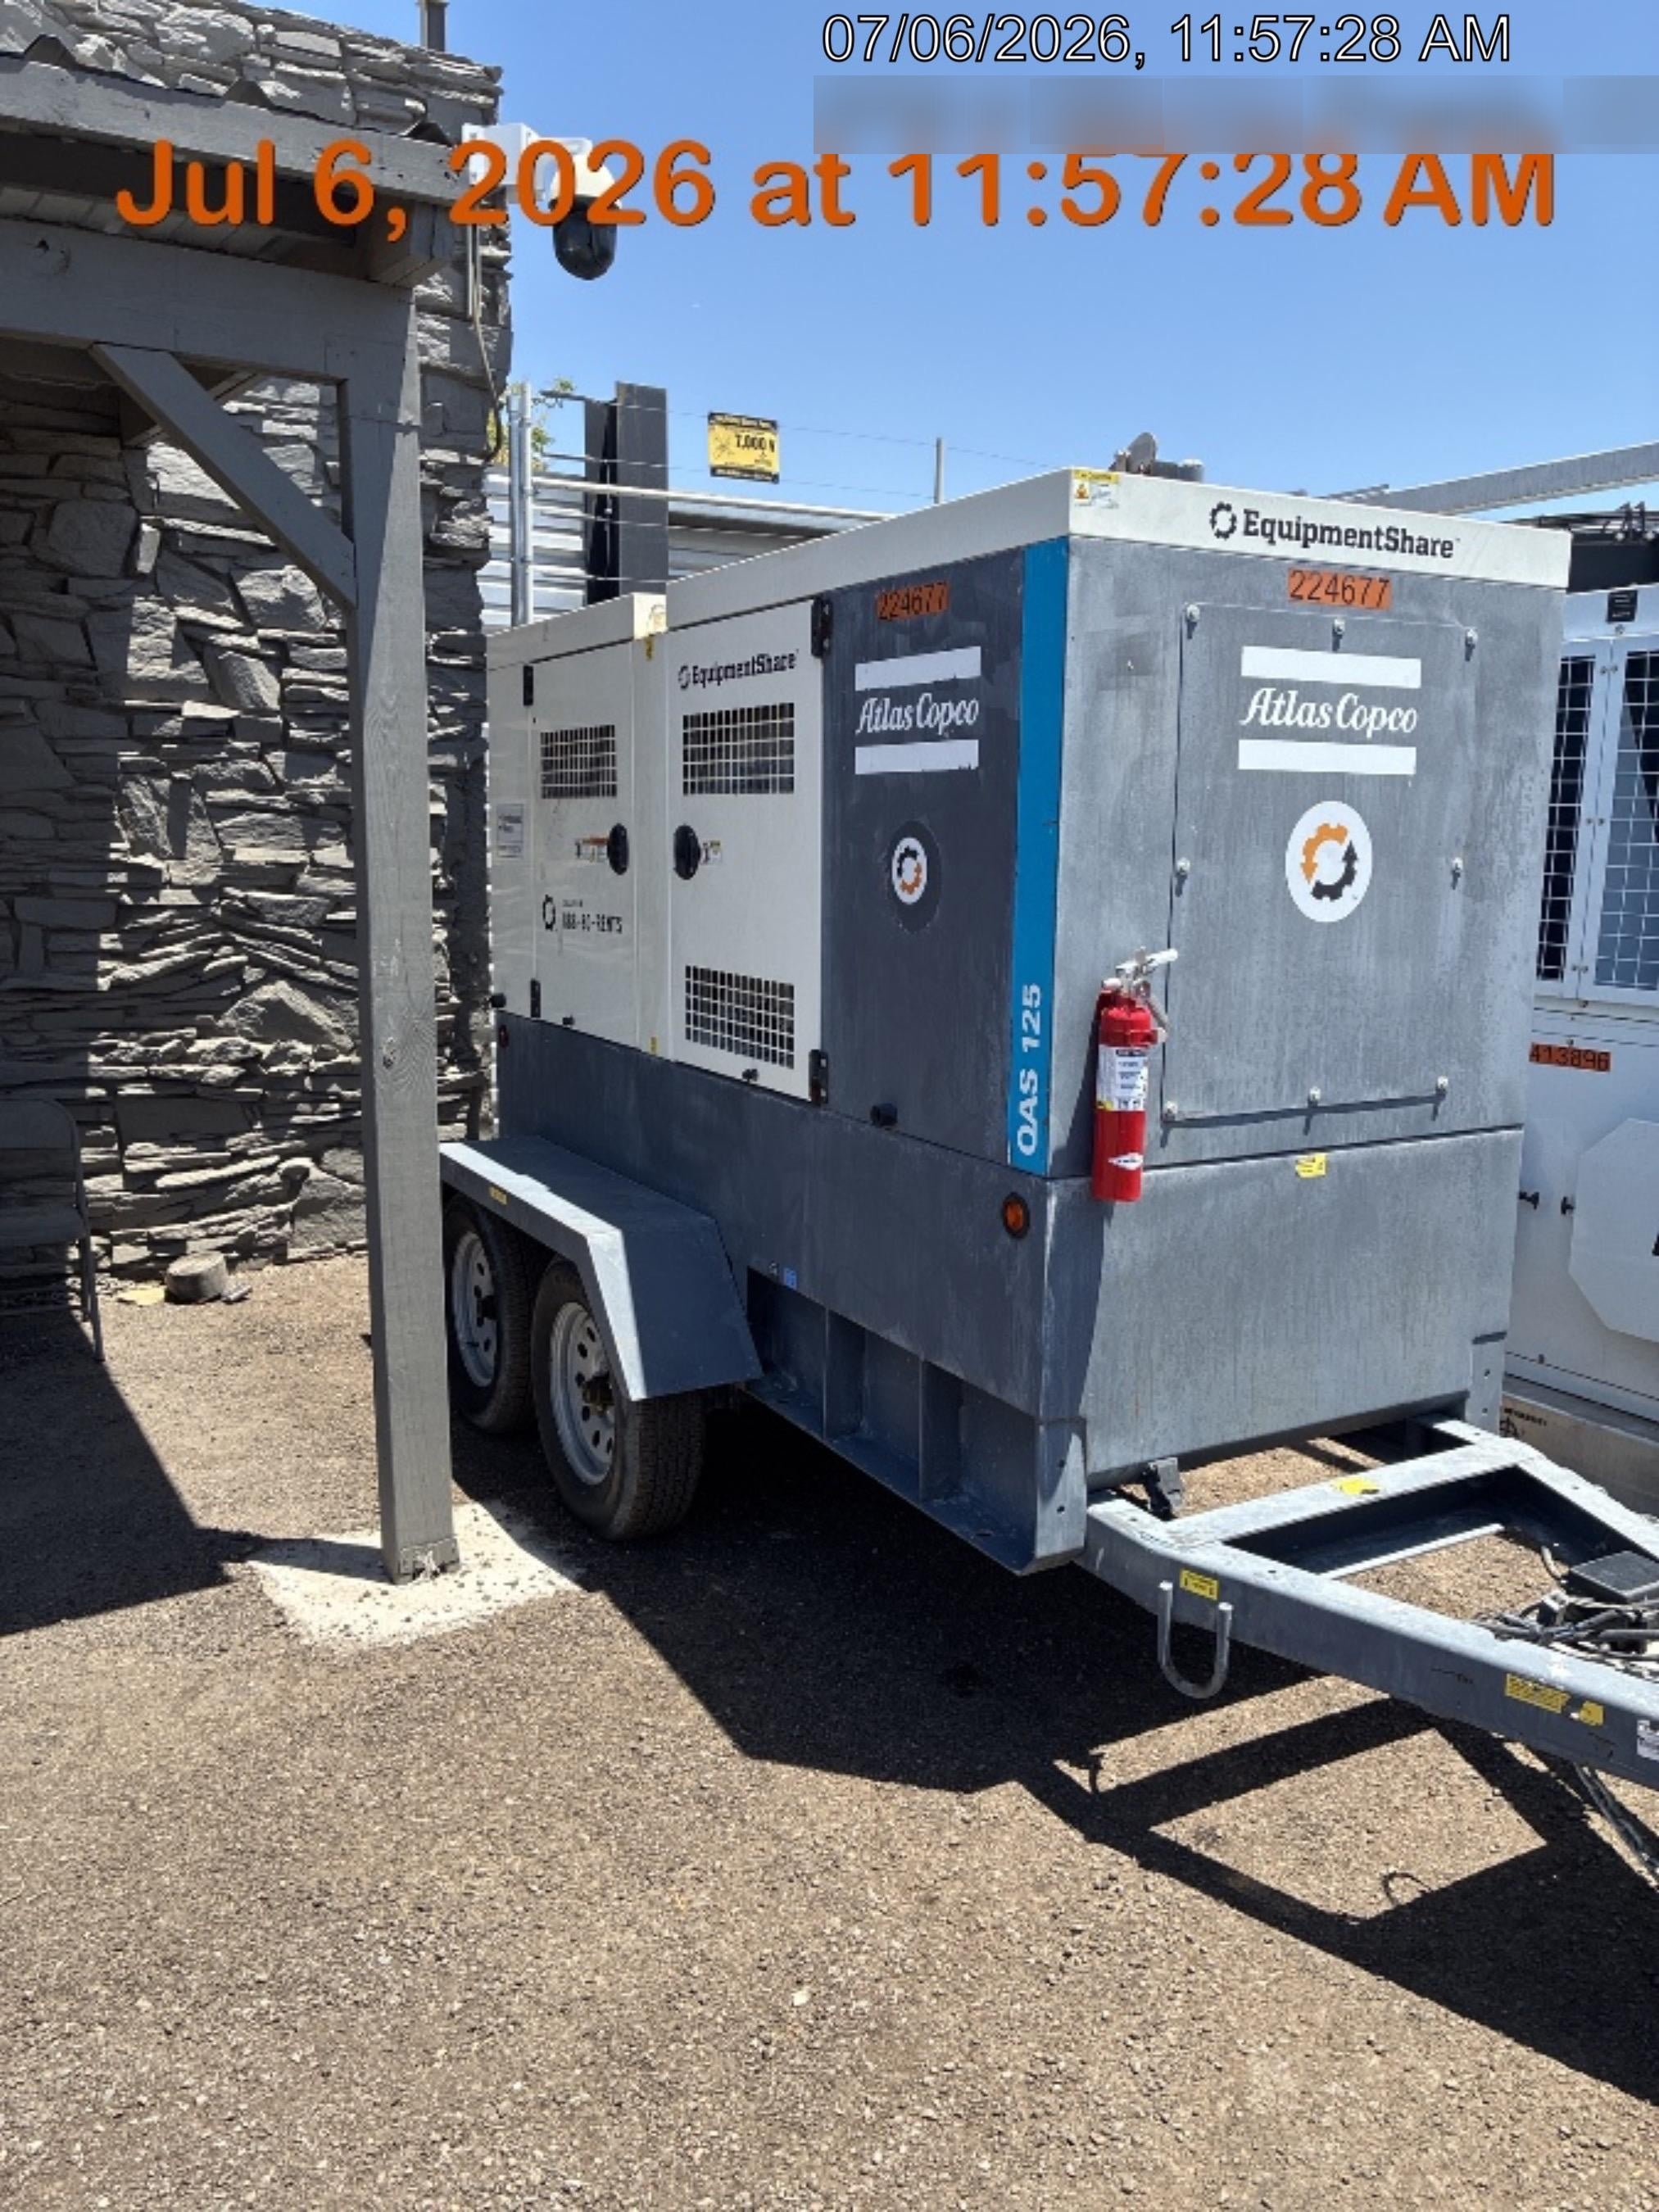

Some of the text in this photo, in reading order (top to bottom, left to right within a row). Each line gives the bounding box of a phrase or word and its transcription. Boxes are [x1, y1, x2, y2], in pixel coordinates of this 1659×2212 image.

[1243, 508, 1454, 559] EquipmentShare
[878, 582, 948, 620] 224677
[1290, 569, 1389, 608] 224677
[692, 653, 796, 688] EquipmentShare
[855, 692, 980, 736] Atlas Copco
[1240, 687, 1420, 738] Atlas Copco
[1022, 982, 1042, 1054] 125
